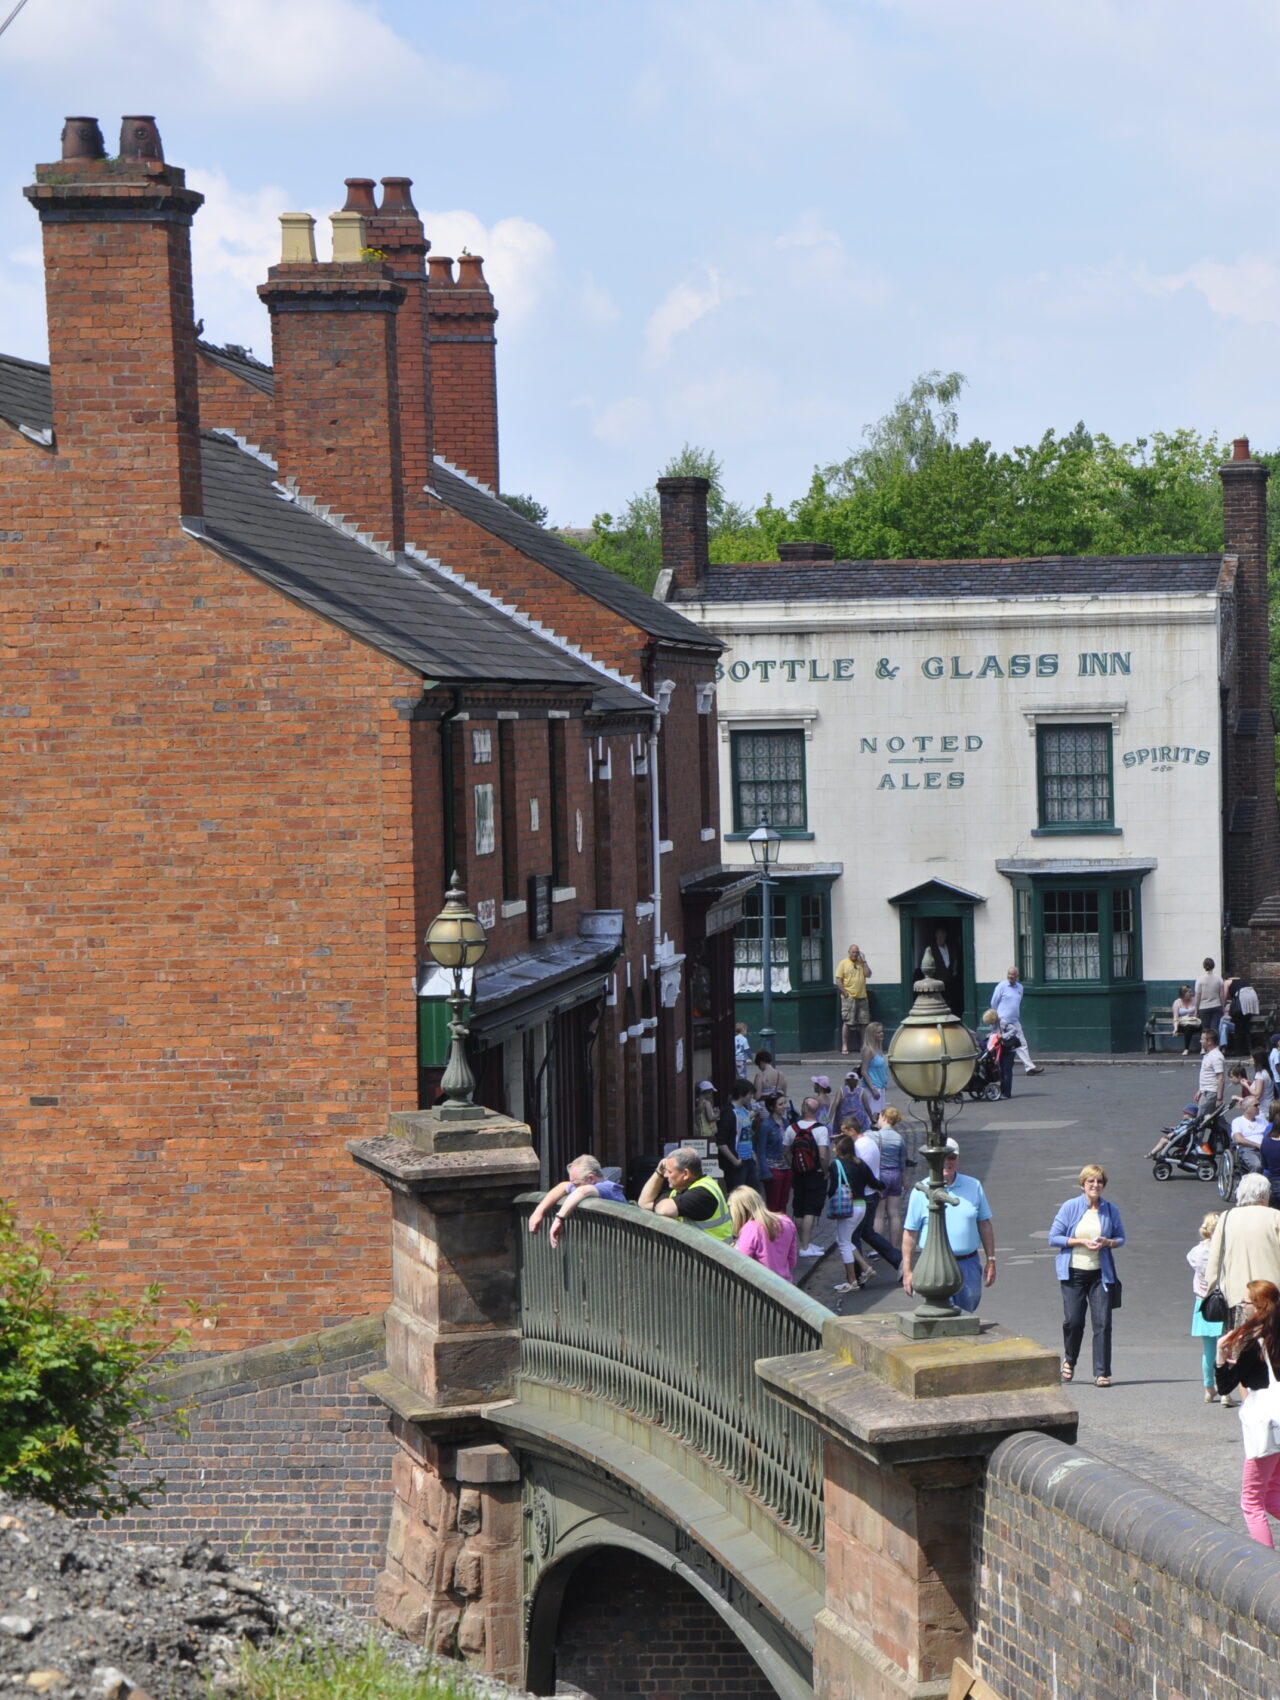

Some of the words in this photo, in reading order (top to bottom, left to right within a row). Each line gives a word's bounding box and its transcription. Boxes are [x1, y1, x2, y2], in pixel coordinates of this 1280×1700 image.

[875, 657, 900, 680] &
[921, 653, 1059, 679] GLASS
[1078, 651, 1131, 677] INN
[859, 735, 984, 754] NOTED
[1122, 746, 1211, 769] SPIRITS
[876, 771, 965, 790] ALES
